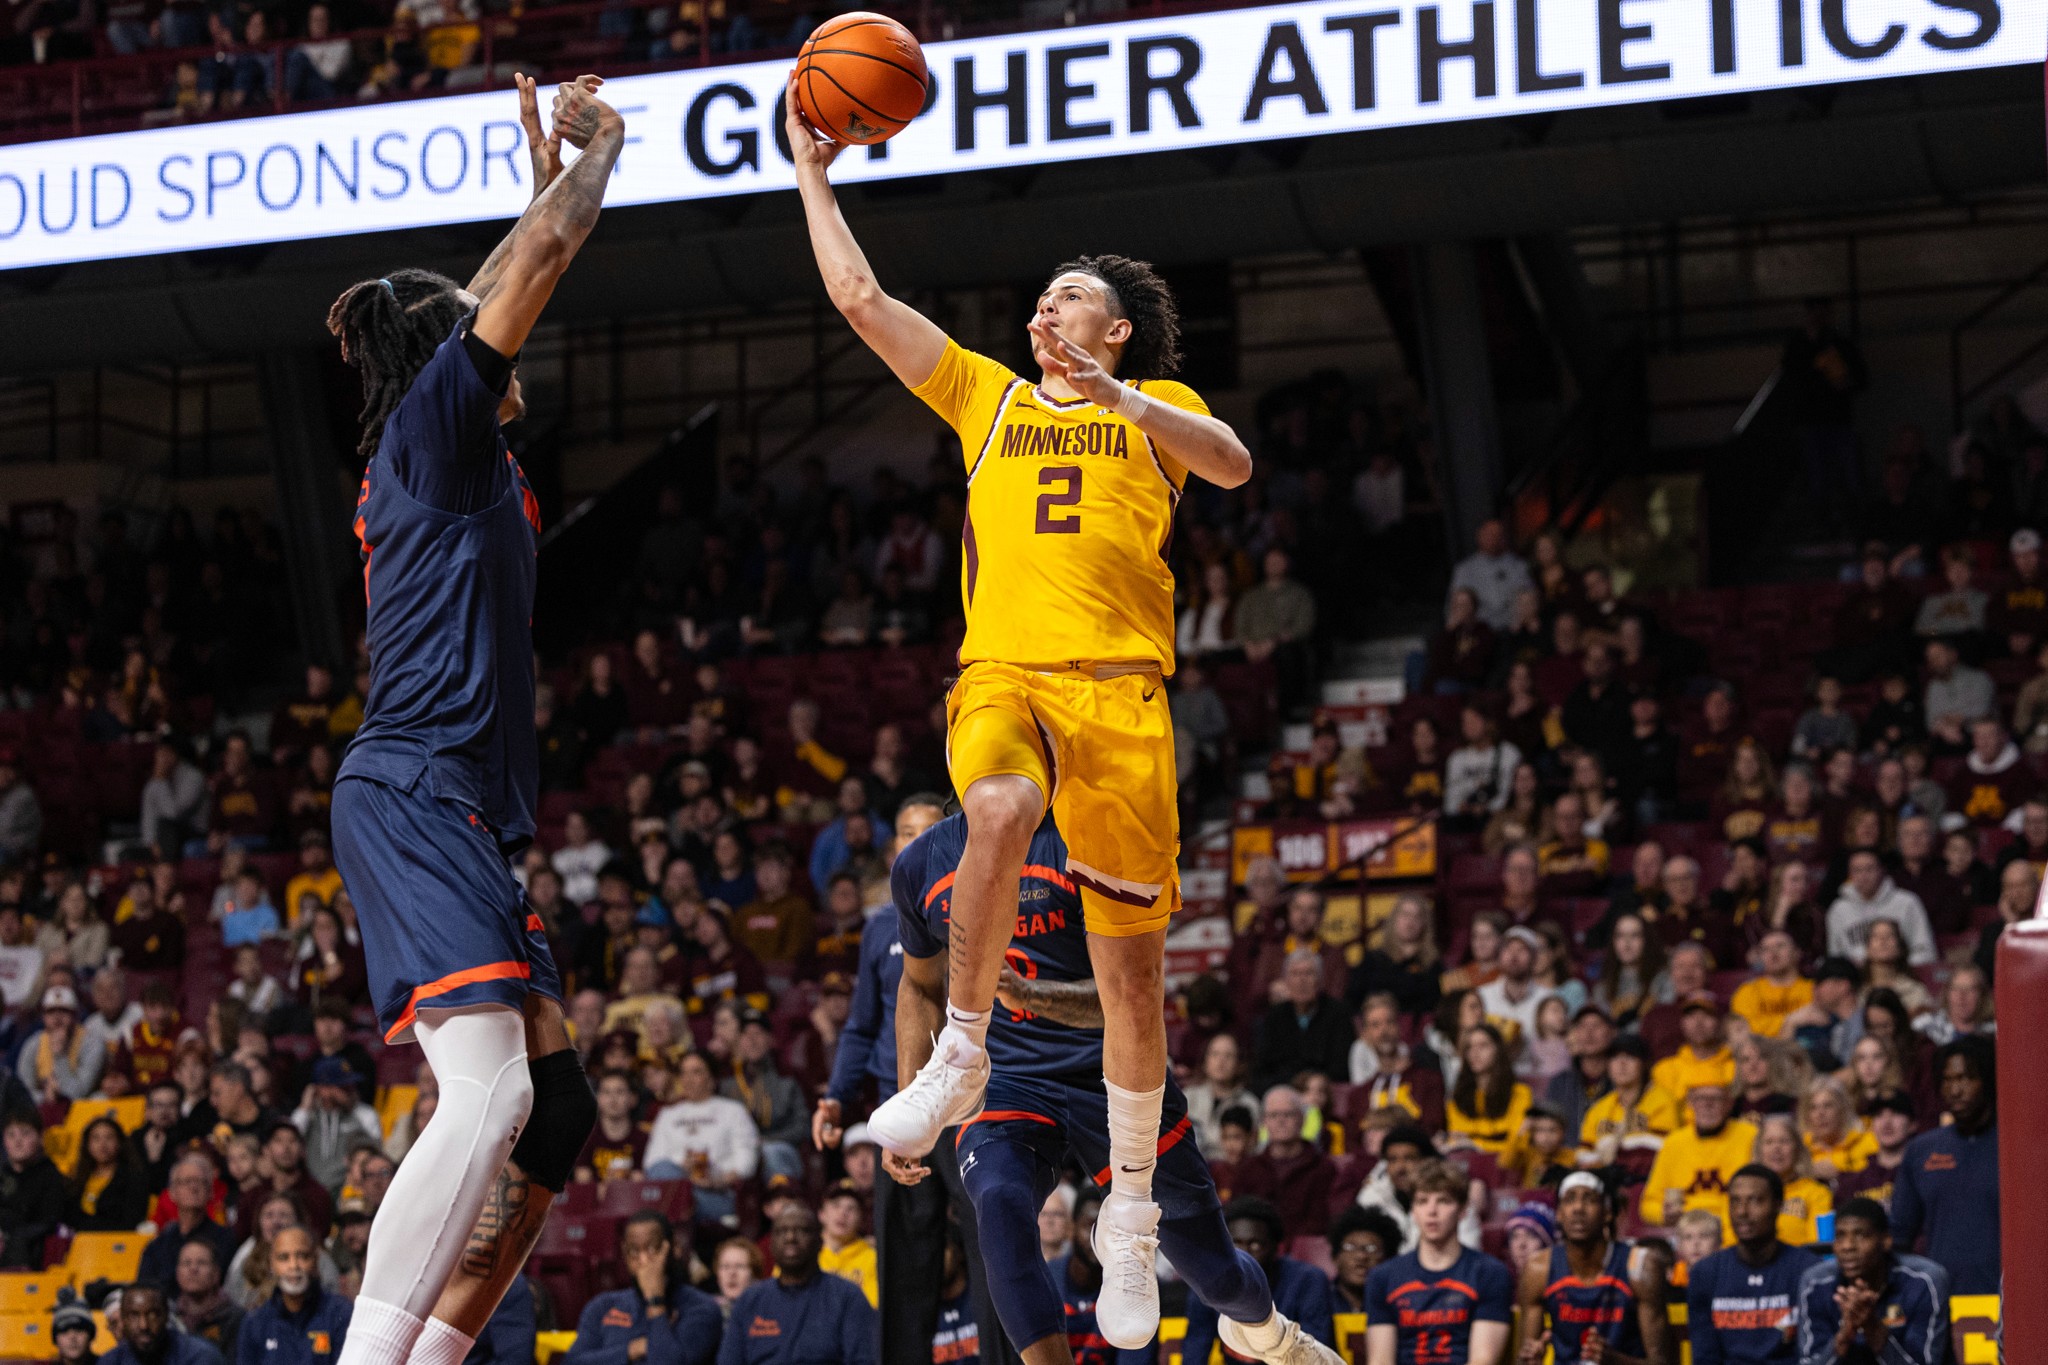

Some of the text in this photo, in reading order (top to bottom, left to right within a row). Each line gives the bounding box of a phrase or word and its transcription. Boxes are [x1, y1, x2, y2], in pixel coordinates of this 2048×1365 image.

[157, 120, 523, 223] SPONSOR
[684, 35, 1205, 179] GHER
[1000, 422, 1129, 460] MINNESOTA
[1035, 466, 1083, 534] 2
[1414, 1331, 1454, 1355] 12
